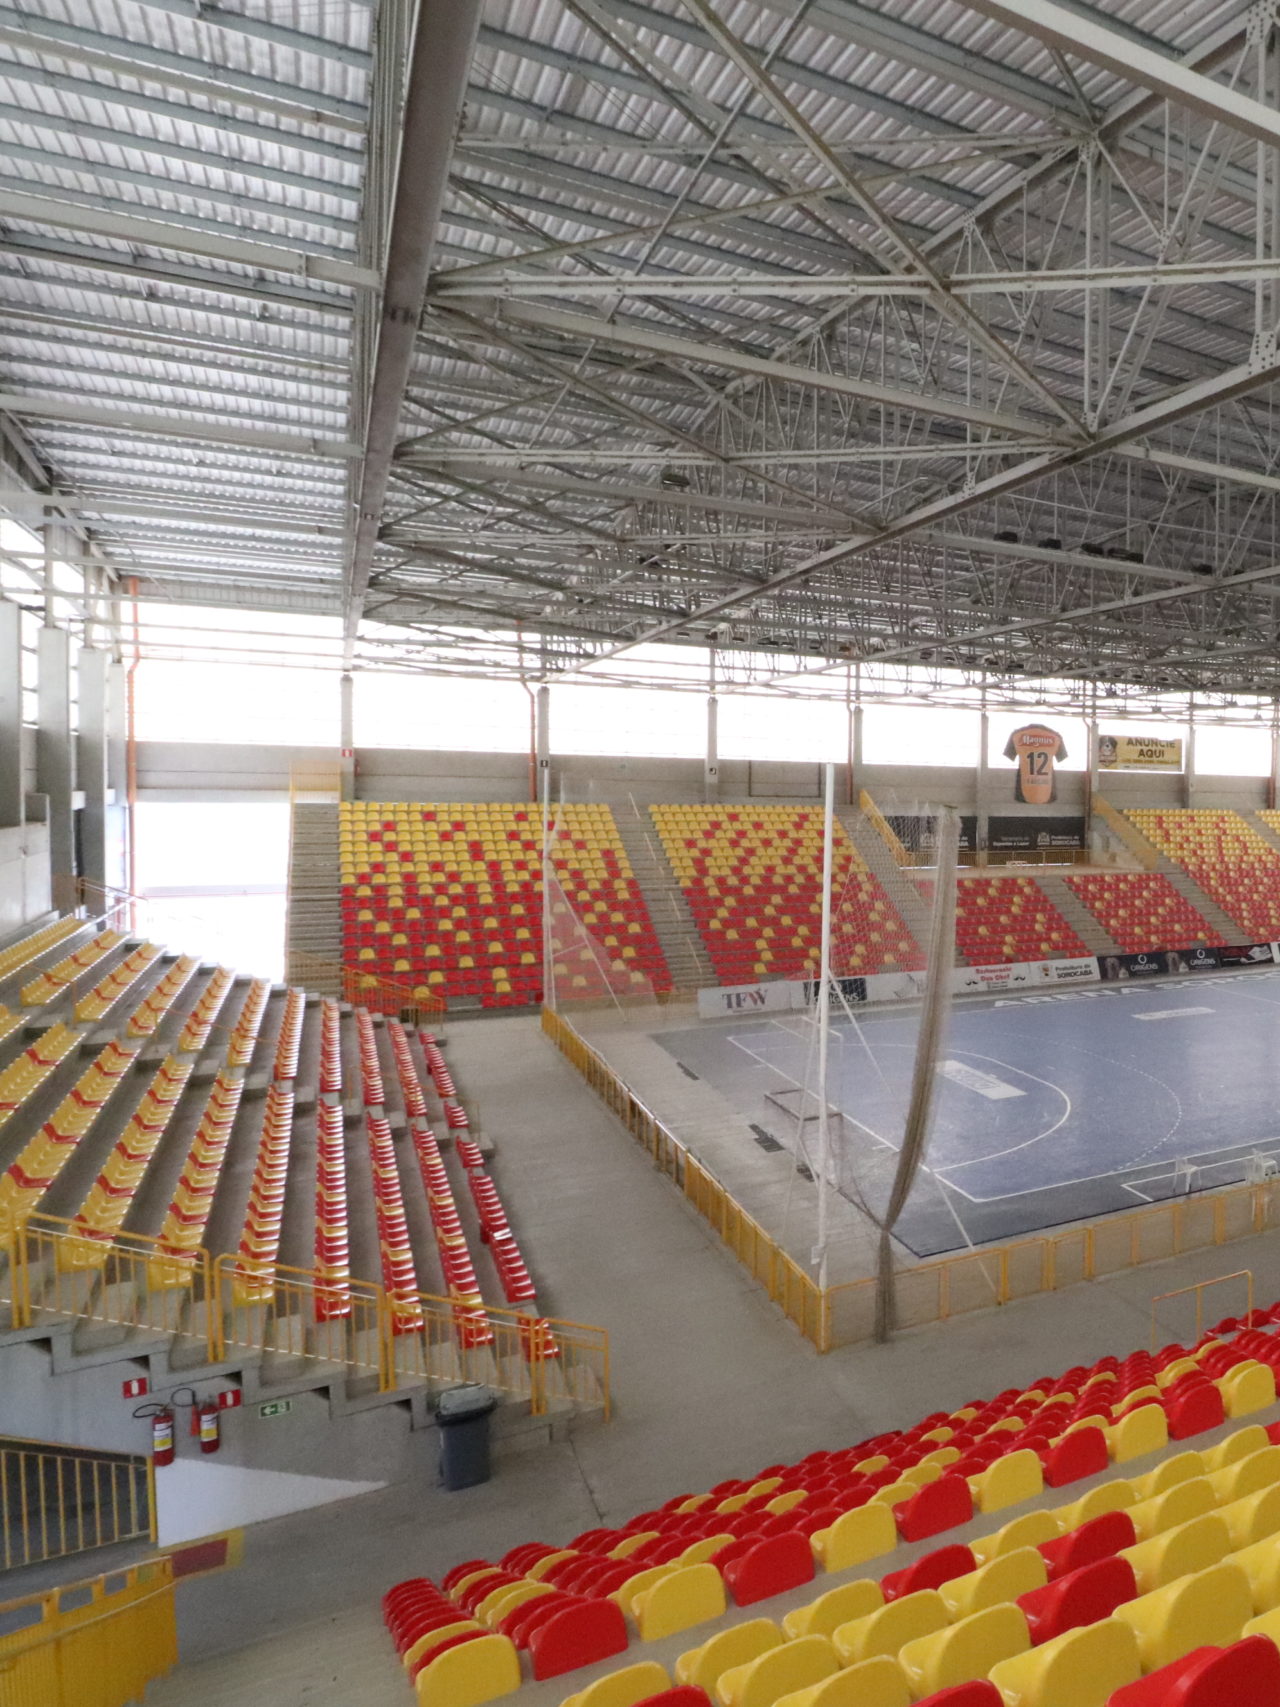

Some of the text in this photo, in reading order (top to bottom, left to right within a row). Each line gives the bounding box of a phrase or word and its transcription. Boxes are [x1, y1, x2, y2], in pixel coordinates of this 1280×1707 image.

[1126, 737, 1176, 749] ANUNCIE
[1137, 748, 1165, 759] AQUI
[1026, 751, 1049, 776] 12
[721, 987, 768, 1009] TFW
[993, 986, 1150, 1008] ARENA
